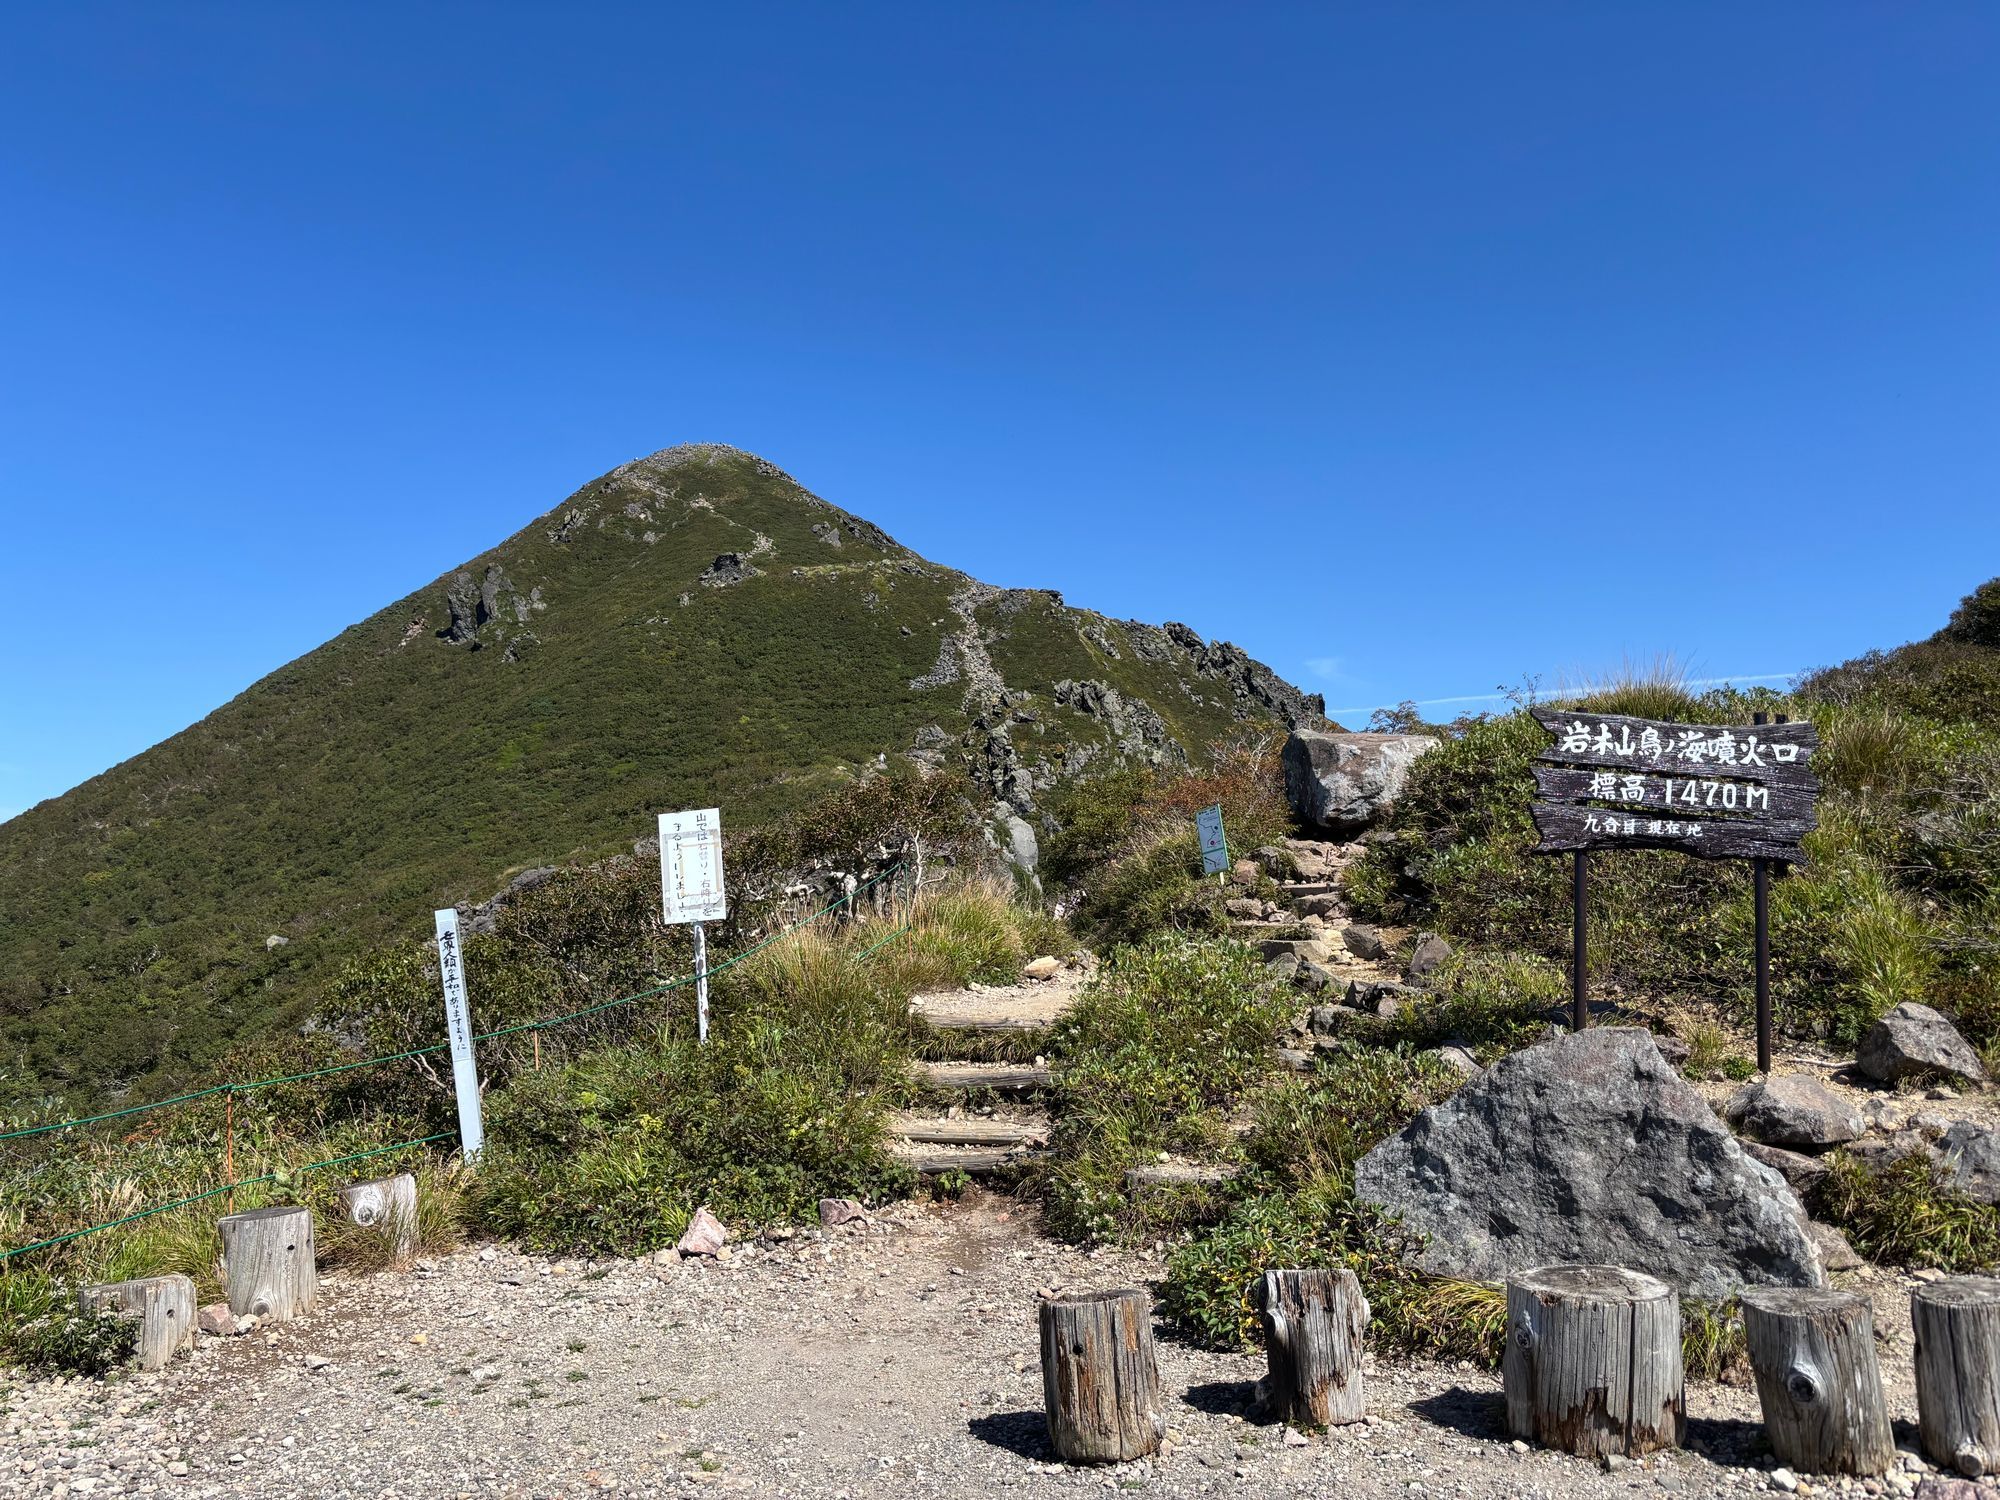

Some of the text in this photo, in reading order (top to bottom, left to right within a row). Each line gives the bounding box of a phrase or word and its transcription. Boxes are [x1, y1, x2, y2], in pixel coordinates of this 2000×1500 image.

[1560, 720, 1800, 767] 岩木山鳥ノ海噴火口
[1588, 772, 1647, 802] 標高
[1583, 813, 1636, 835] 九合目
[440, 930, 467, 1051] 世界人類が平和でありますように
